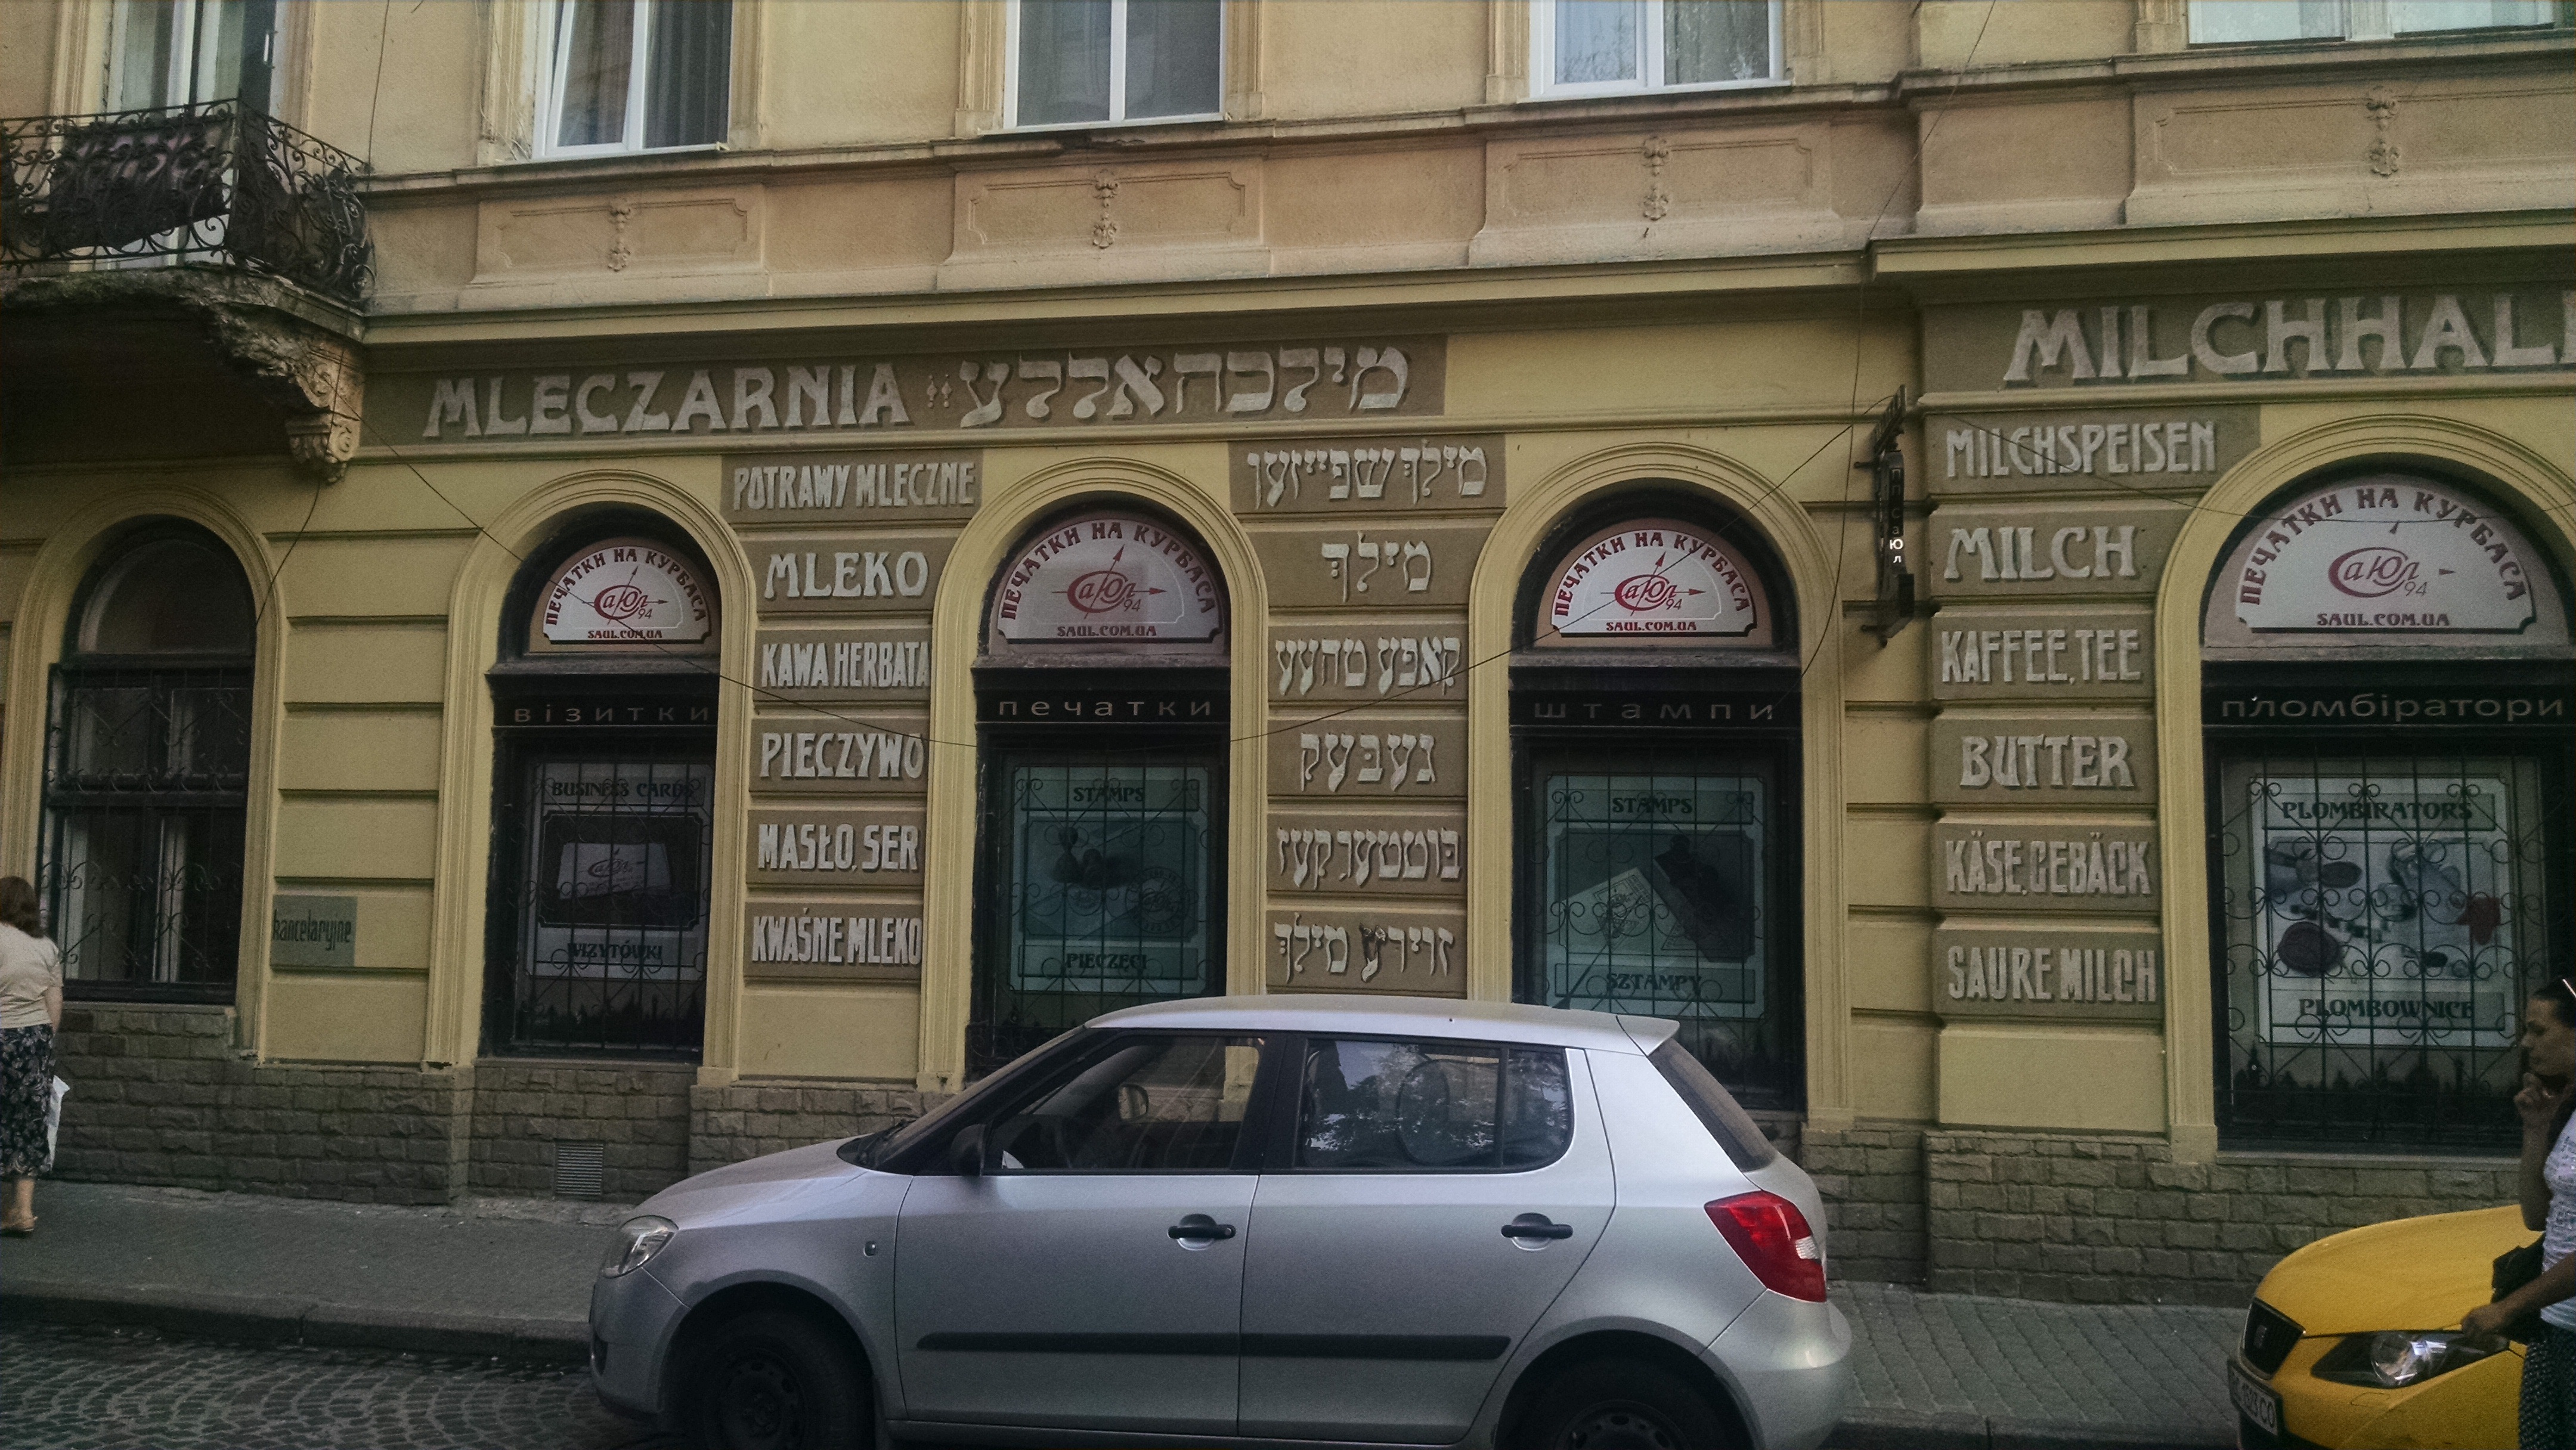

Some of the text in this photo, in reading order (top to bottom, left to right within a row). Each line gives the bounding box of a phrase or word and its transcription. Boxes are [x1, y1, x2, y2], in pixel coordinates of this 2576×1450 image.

[422, 363, 911, 437] MLECZARNIA
[1946, 421, 2216, 476] MILCHSPEISEN
[733, 462, 976, 511] POTRAWY MLECZNE
[1944, 526, 2136, 580] MILCH
[2240, 488, 2526, 605] ПЕЧАТКИ НА КУРБАСА
[546, 549, 707, 625] ПЕЧАТКИ НА КУРБАСА
[764, 552, 928, 600] MLEKO
[1001, 522, 1216, 620] ПЕЧАТКИ НА КУРБАСА
[1555, 532, 1751, 616] ПЕЧАТКИ НА КУРБАСА
[2404, 581, 2428, 597] 94
[637, 608, 652, 619] 94
[1123, 599, 1141, 612] 94
[1665, 598, 1682, 611] 94
[2317, 613, 2450, 626] SAUL.COM.UA
[587, 630, 662, 639] SAUL.COM.UA
[1057, 626, 1156, 637] SAUL.COM.UA
[1606, 622, 1697, 631] SAUL.COM.UA
[761, 641, 929, 687] KAWA HERBATA
[1942, 629, 2141, 685] KAFFEE, TEE
[514, 704, 709, 723] візитки
[999, 701, 1210, 716] печатки
[1534, 702, 1773, 720] штампи
[2222, 693, 2563, 722] пломбіратори
[761, 732, 924, 779] PIECZYWO
[1960, 734, 2135, 788] BUTTER
[1073, 786, 1145, 803] STAMPS
[1612, 797, 1693, 814] STAMPS
[2282, 802, 2473, 820] PLOMBIRATORS
[758, 823, 919, 871] MASŁO, SER
[1946, 830, 2151, 896] KÄSE, GEBÄCK
[752, 907, 922, 965] KWAŚNE MLEKO
[1607, 973, 1702, 991] SZTAMPY
[1948, 946, 2157, 1003] SAURE MILCH
[2299, 997, 2474, 1019] PLOMBOWNICE
